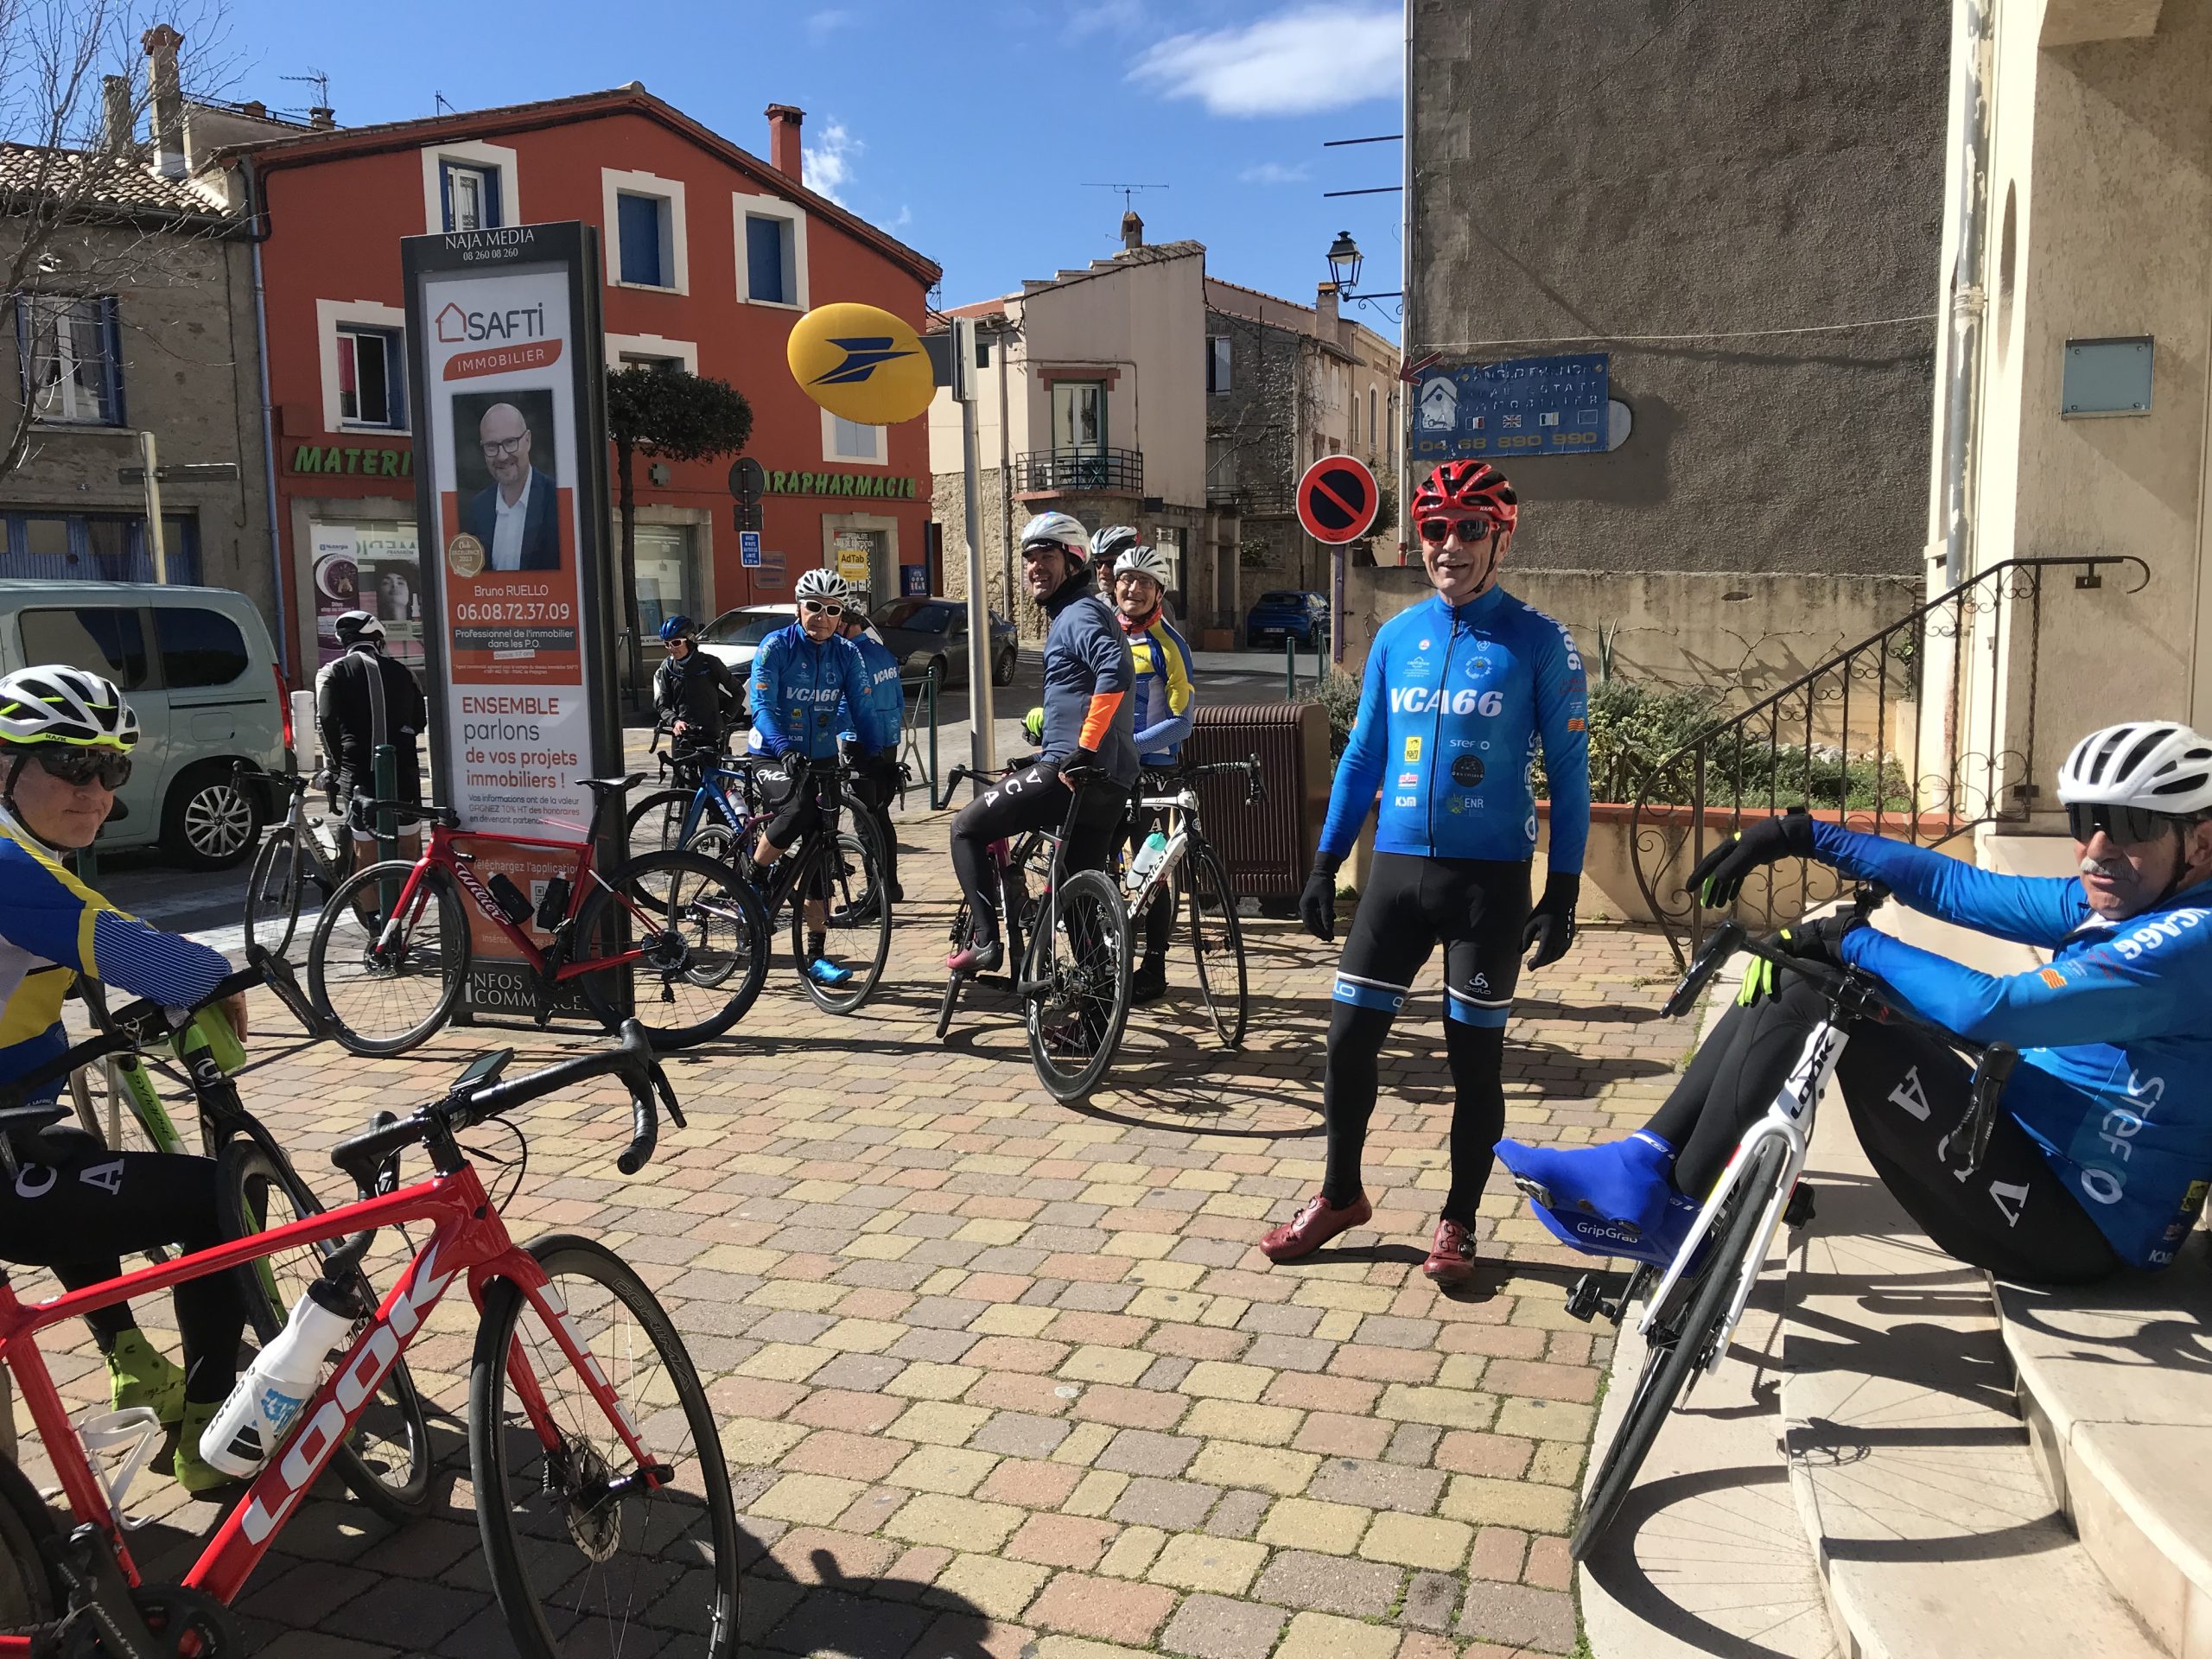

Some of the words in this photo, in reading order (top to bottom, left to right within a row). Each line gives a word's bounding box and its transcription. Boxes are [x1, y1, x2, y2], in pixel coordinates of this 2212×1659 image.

[445, 233, 481, 251] NAJA
[486, 228, 534, 245] MEDIA
[463, 251, 474, 261] 08
[475, 250, 490, 260] 260
[492, 249, 502, 259] 08
[504, 247, 518, 257] 260
[457, 348, 545, 372] IMMOBILIER
[1419, 440, 1447, 452] 04
[1459, 437, 1486, 449] 68
[1497, 435, 1541, 448] 890
[1552, 431, 1597, 445] 990
[841, 554, 865, 563] AdTab
[474, 586, 504, 597] Bruno
[505, 585, 549, 596] RUELLO
[456, 603, 570, 620] 06.08.72.37.09
[454, 629, 512, 639] Professionnel
[513, 630, 524, 639] de
[526, 629, 575, 639] l'immobilier
[487, 639, 509, 648] dans
[511, 639, 523, 648] les
[785, 687, 840, 702] VCA66
[1390, 687, 1503, 716] VCA66
[462, 696, 560, 715] ENSEMBLE
[45, 734, 67, 742] KASK
[464, 718, 540, 744] parlons
[465, 747, 485, 764] de
[489, 750, 516, 764] vos
[521, 748, 578, 769] projets
[466, 769, 556, 789] immobiliers
[561, 772, 566, 788] !
[984, 768, 1043, 808] VCA
[482, 793, 525, 804] informations
[526, 796, 539, 804] ont
[539, 796, 550, 804] de
[550, 796, 557, 804] la
[558, 797, 580, 805] valeur
[1465, 798, 1484, 808] ENR
[468, 804, 499, 813] GAGNEZ
[502, 804, 516, 814] 10%
[518, 805, 528, 814] HT
[529, 806, 542, 815] des
[543, 807, 580, 817] honoraires
[479, 814, 512, 824] devenant
[455, 861, 512, 925] Wilier
[2113, 907, 2212, 961] VCA66
[1464, 985, 1491, 995] odlo
[1789, 1036, 1836, 1120] LOOK
[611, 1278, 692, 1392] CORIMA
[241, 1240, 455, 1547] LOOK
[208, 1379, 245, 1434] GIANT
